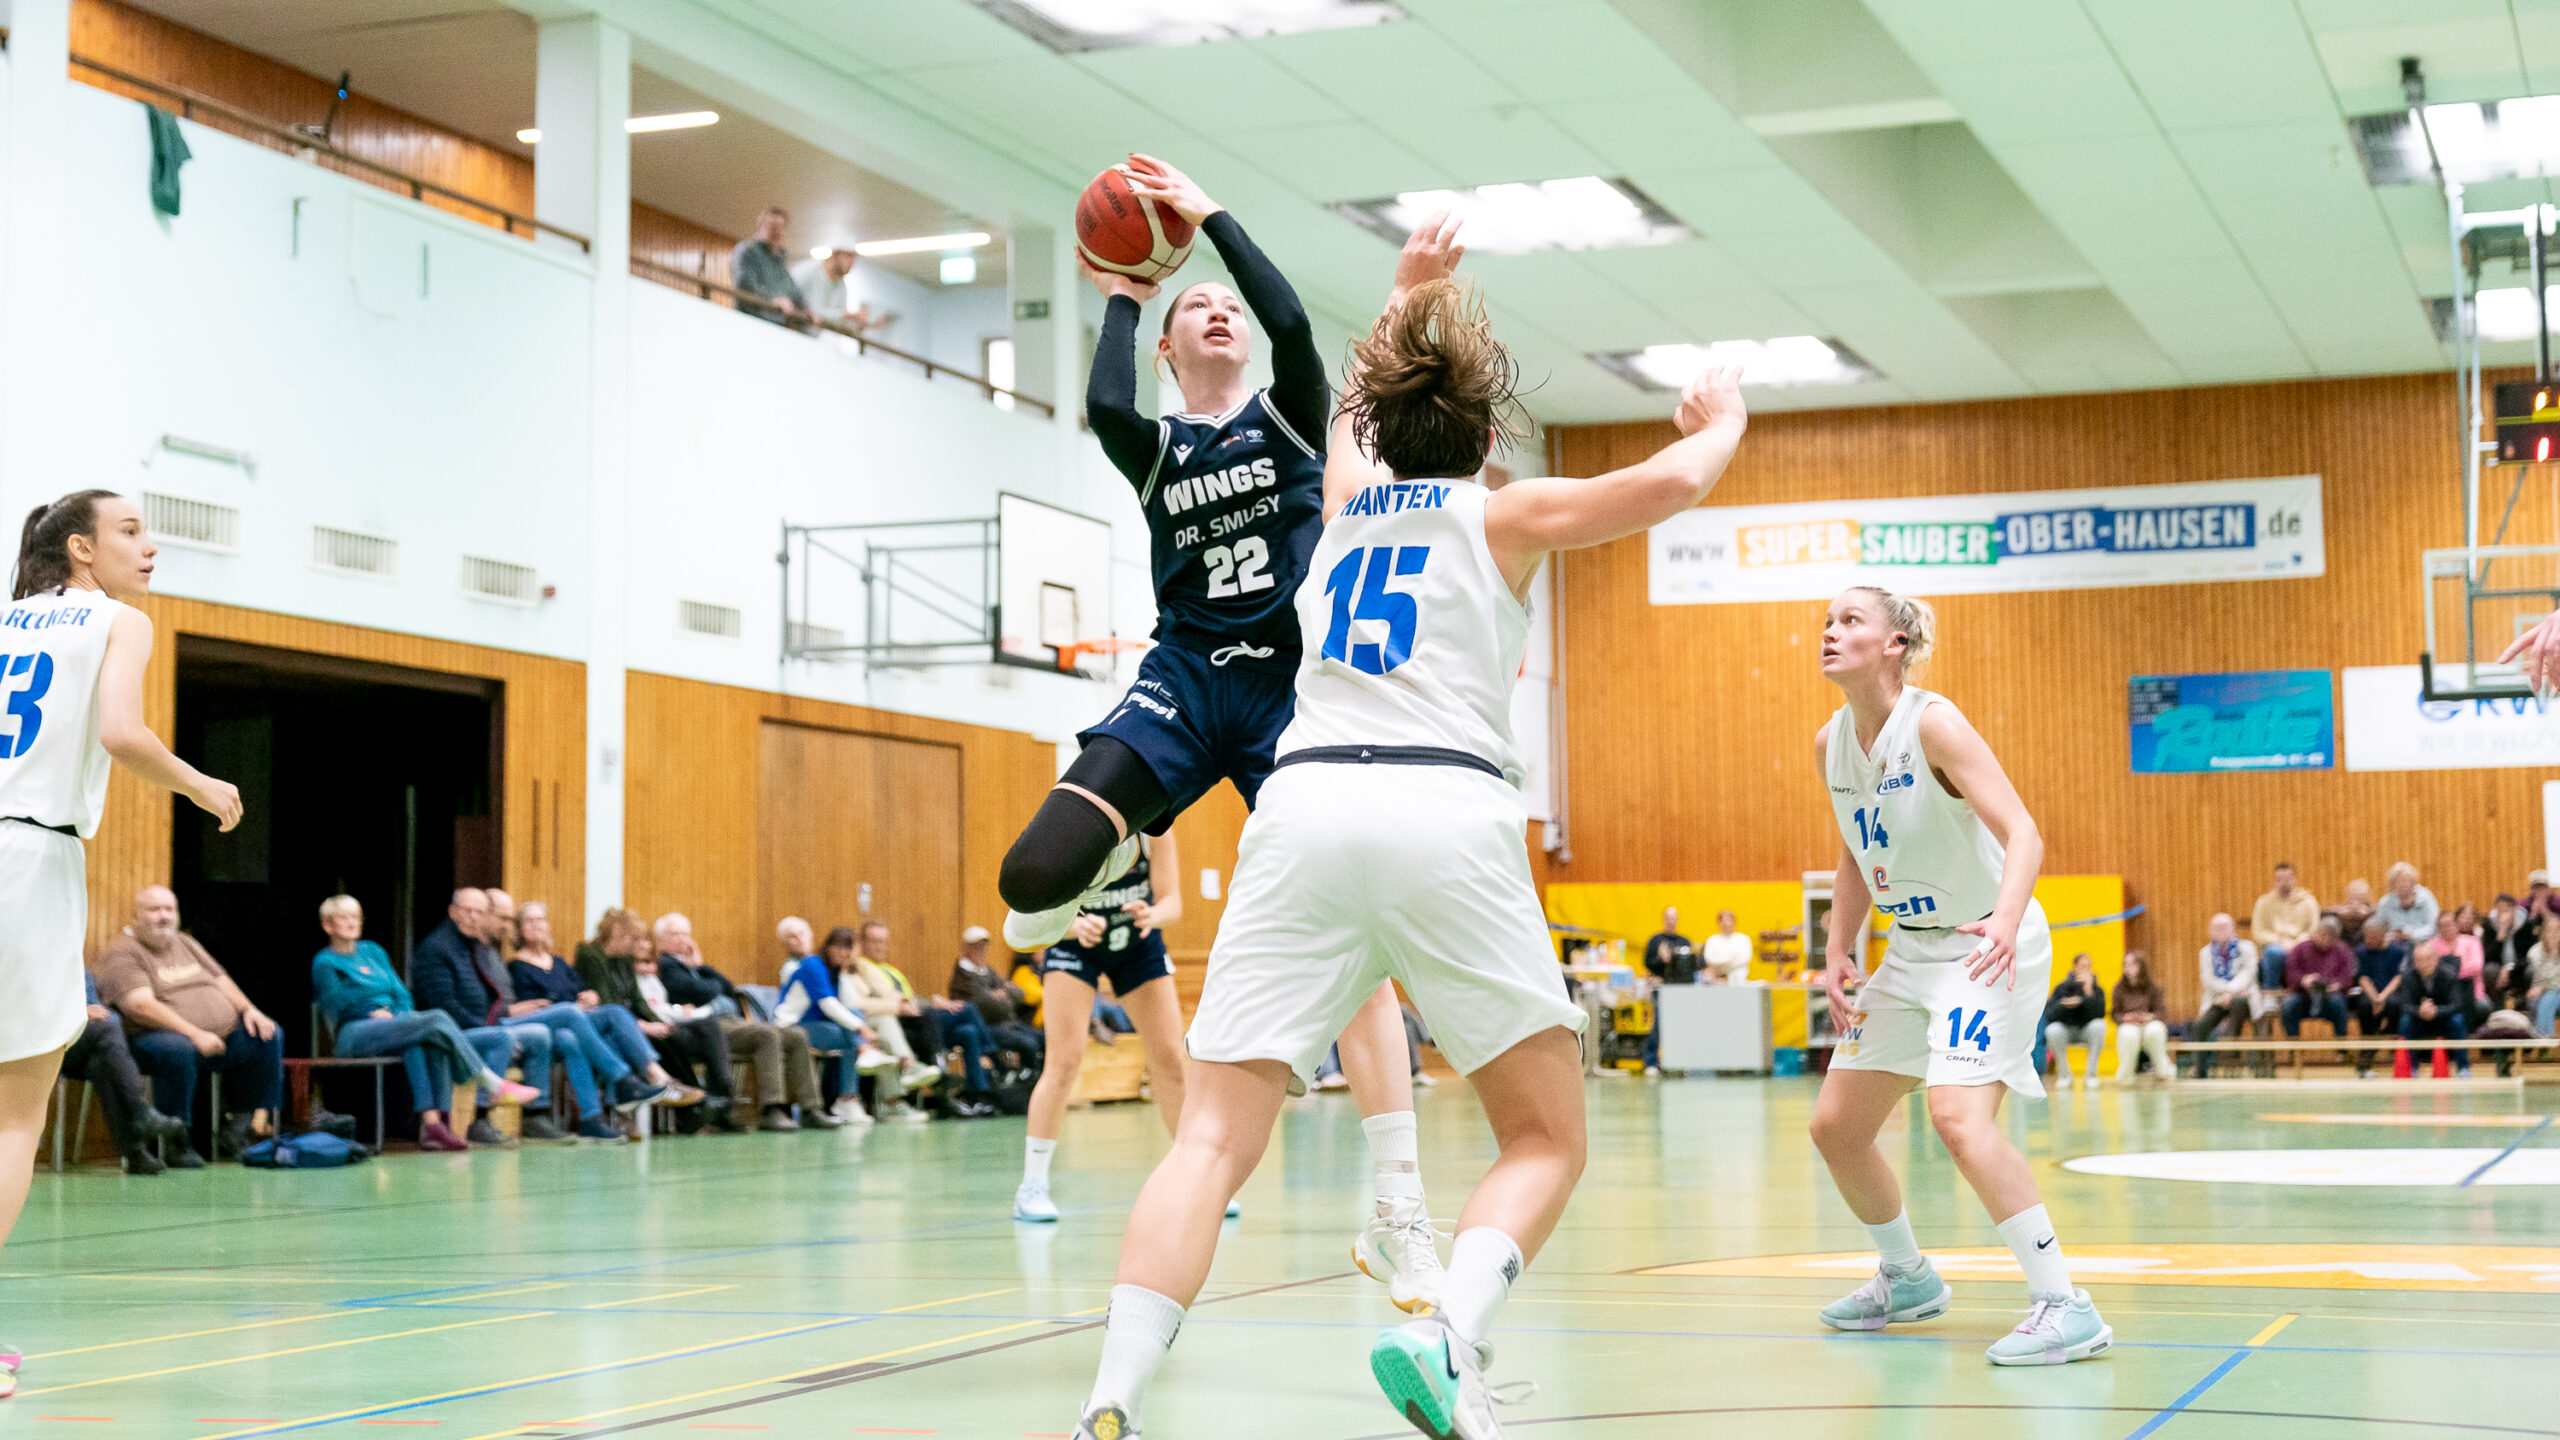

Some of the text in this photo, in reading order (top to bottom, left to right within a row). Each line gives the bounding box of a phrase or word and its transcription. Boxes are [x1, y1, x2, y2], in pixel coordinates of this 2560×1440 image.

[1163, 457, 1277, 516] WINGS
[1175, 524, 1206, 550] DR.
[1203, 535, 1275, 599] 22
[1321, 546, 1431, 676] 15
[1854, 807, 1889, 850] 14
[1108, 926, 1131, 951] 9
[1948, 1007, 1991, 1052] 14
[1946, 1055, 1979, 1064] CRAFT
